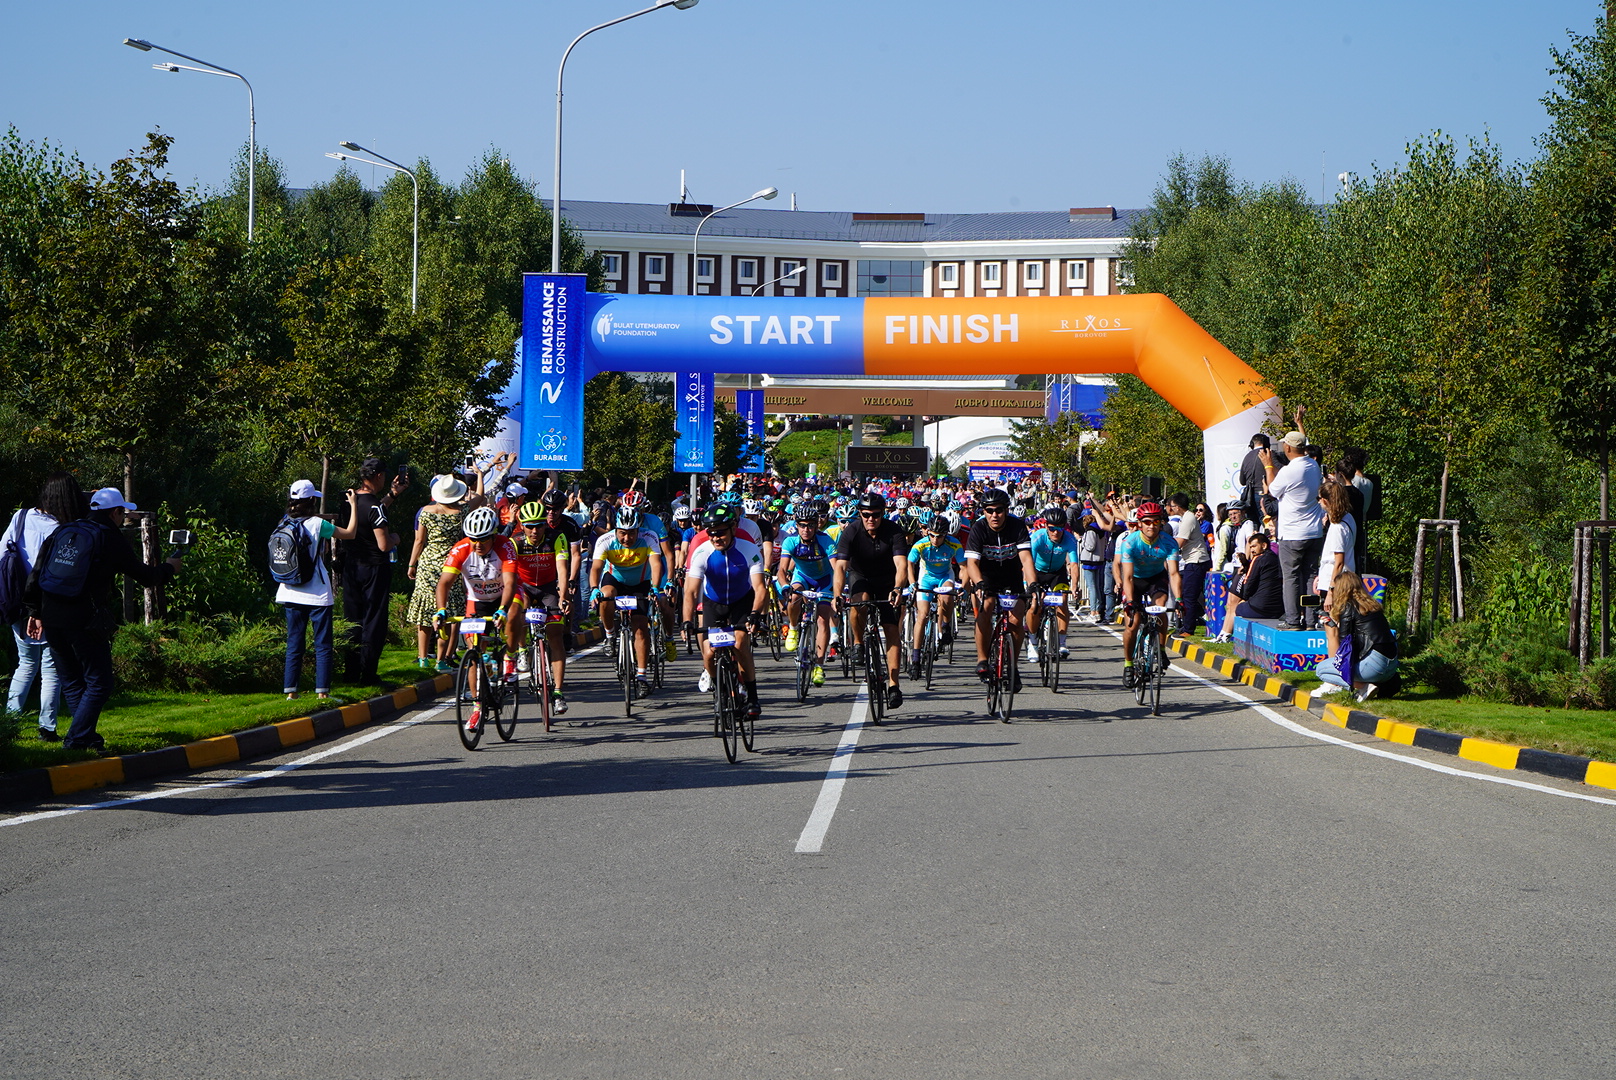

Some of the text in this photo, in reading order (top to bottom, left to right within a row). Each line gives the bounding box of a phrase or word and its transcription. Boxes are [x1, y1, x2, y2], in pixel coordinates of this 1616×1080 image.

[541, 282, 554, 374] RENAISSANCE
[635, 322, 681, 330] UTEMURATOV
[885, 313, 1019, 344] FINISH
[1060, 314, 1121, 331] RIXOS
[556, 287, 567, 374] CONSTRUCTION
[613, 329, 657, 337] FOUNDATION
[709, 314, 840, 345] START
[685, 372, 700, 423] RIXOS
[861, 397, 914, 407] WELCOME
[954, 398, 989, 408] ДОБРО
[864, 450, 911, 463] RIXOS
[715, 633, 729, 641] 001
[1307, 637, 1329, 649] ПР
